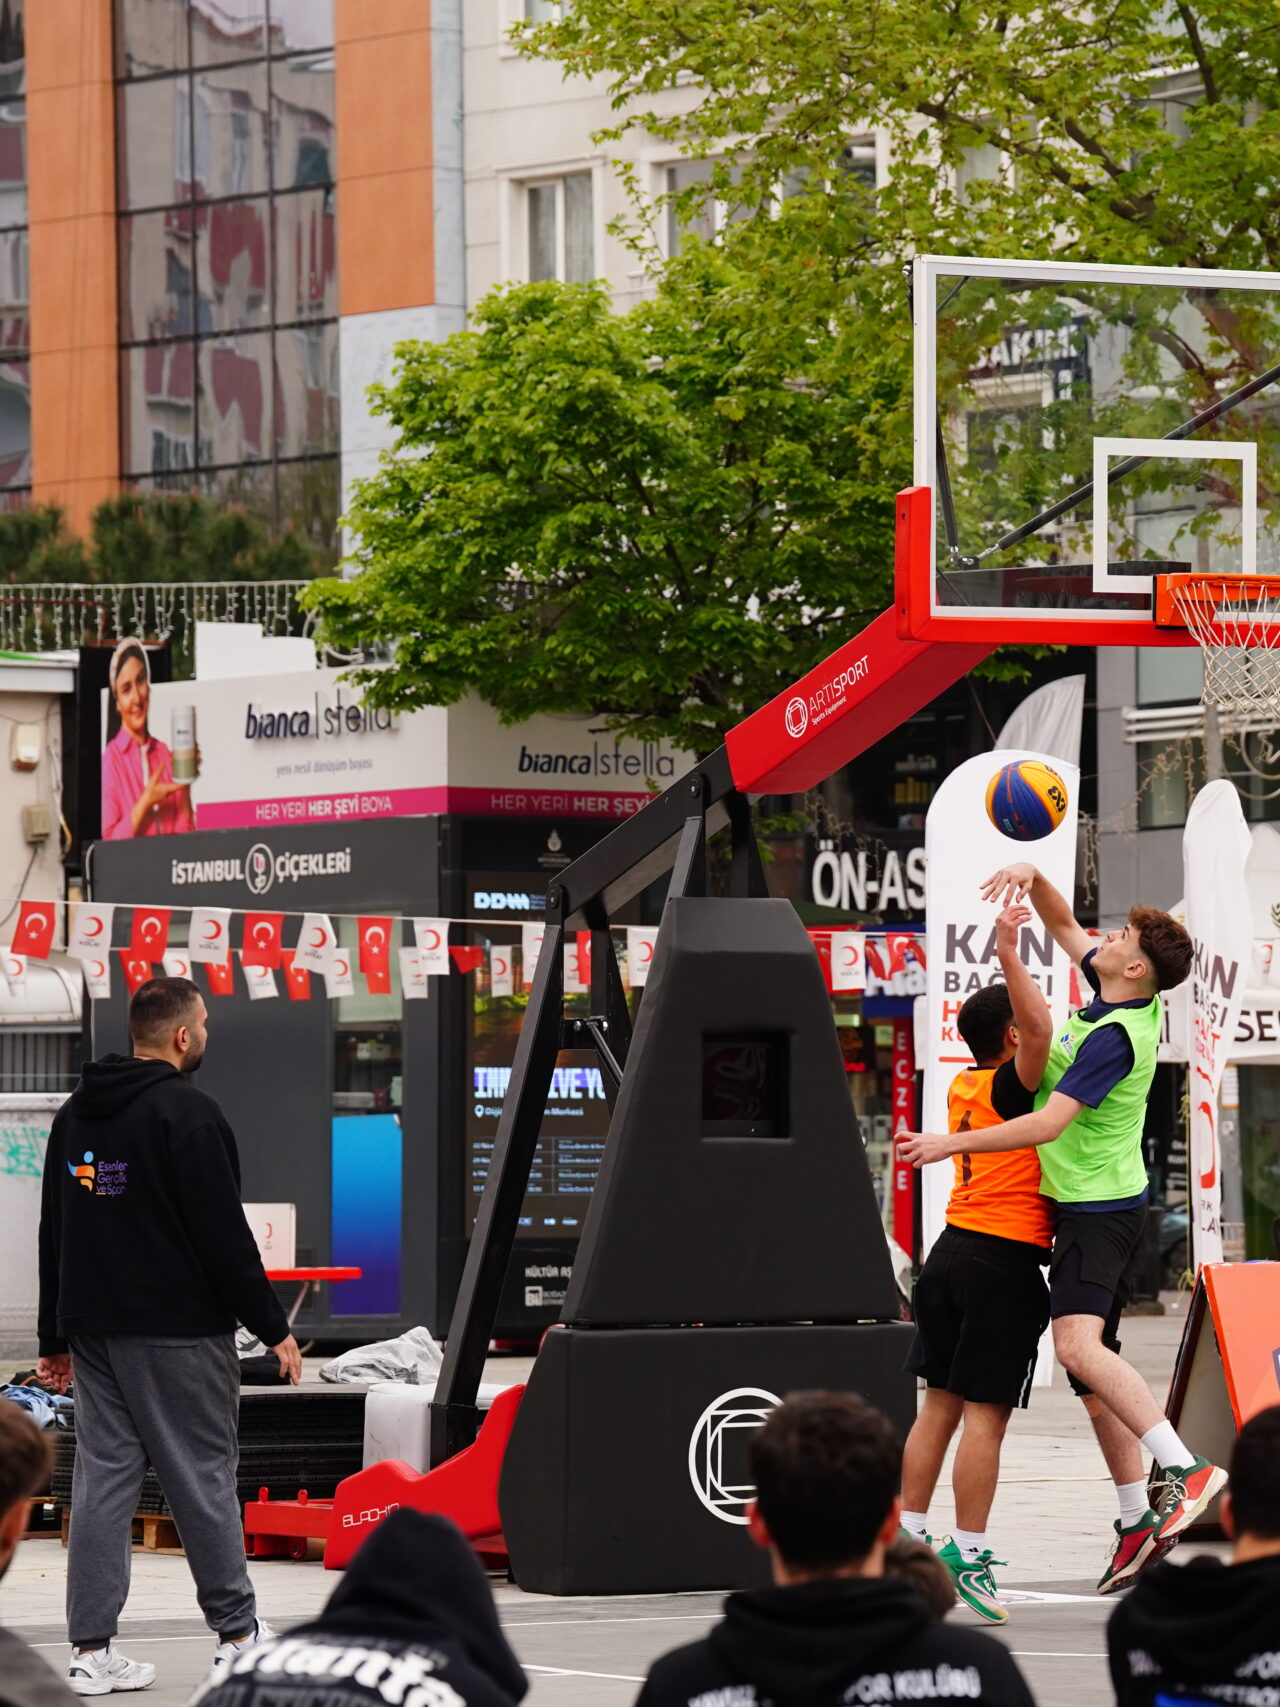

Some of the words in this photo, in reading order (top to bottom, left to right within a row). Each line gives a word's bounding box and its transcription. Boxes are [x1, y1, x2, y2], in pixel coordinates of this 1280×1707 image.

[810, 655, 868, 715] ARTISPORT
[245, 703, 310, 739] bianca
[518, 745, 591, 774] bianca
[599, 736, 675, 777] stella
[255, 804, 280, 820] HER
[280, 800, 306, 818] YERİ
[308, 799, 332, 817] HER
[334, 794, 359, 819] ŞEYİ
[361, 796, 392, 812] BOYA
[490, 794, 527, 810] HER
[530, 795, 569, 811] YERİ
[572, 798, 609, 812] HER
[171, 859, 244, 885] İSTANBUL
[275, 846, 352, 883] ÇİÇEKLERİ
[96, 1173, 128, 1185] Gençlik
[98, 1160, 128, 1172] Esenler
[107, 1184, 125, 1198] Spor
